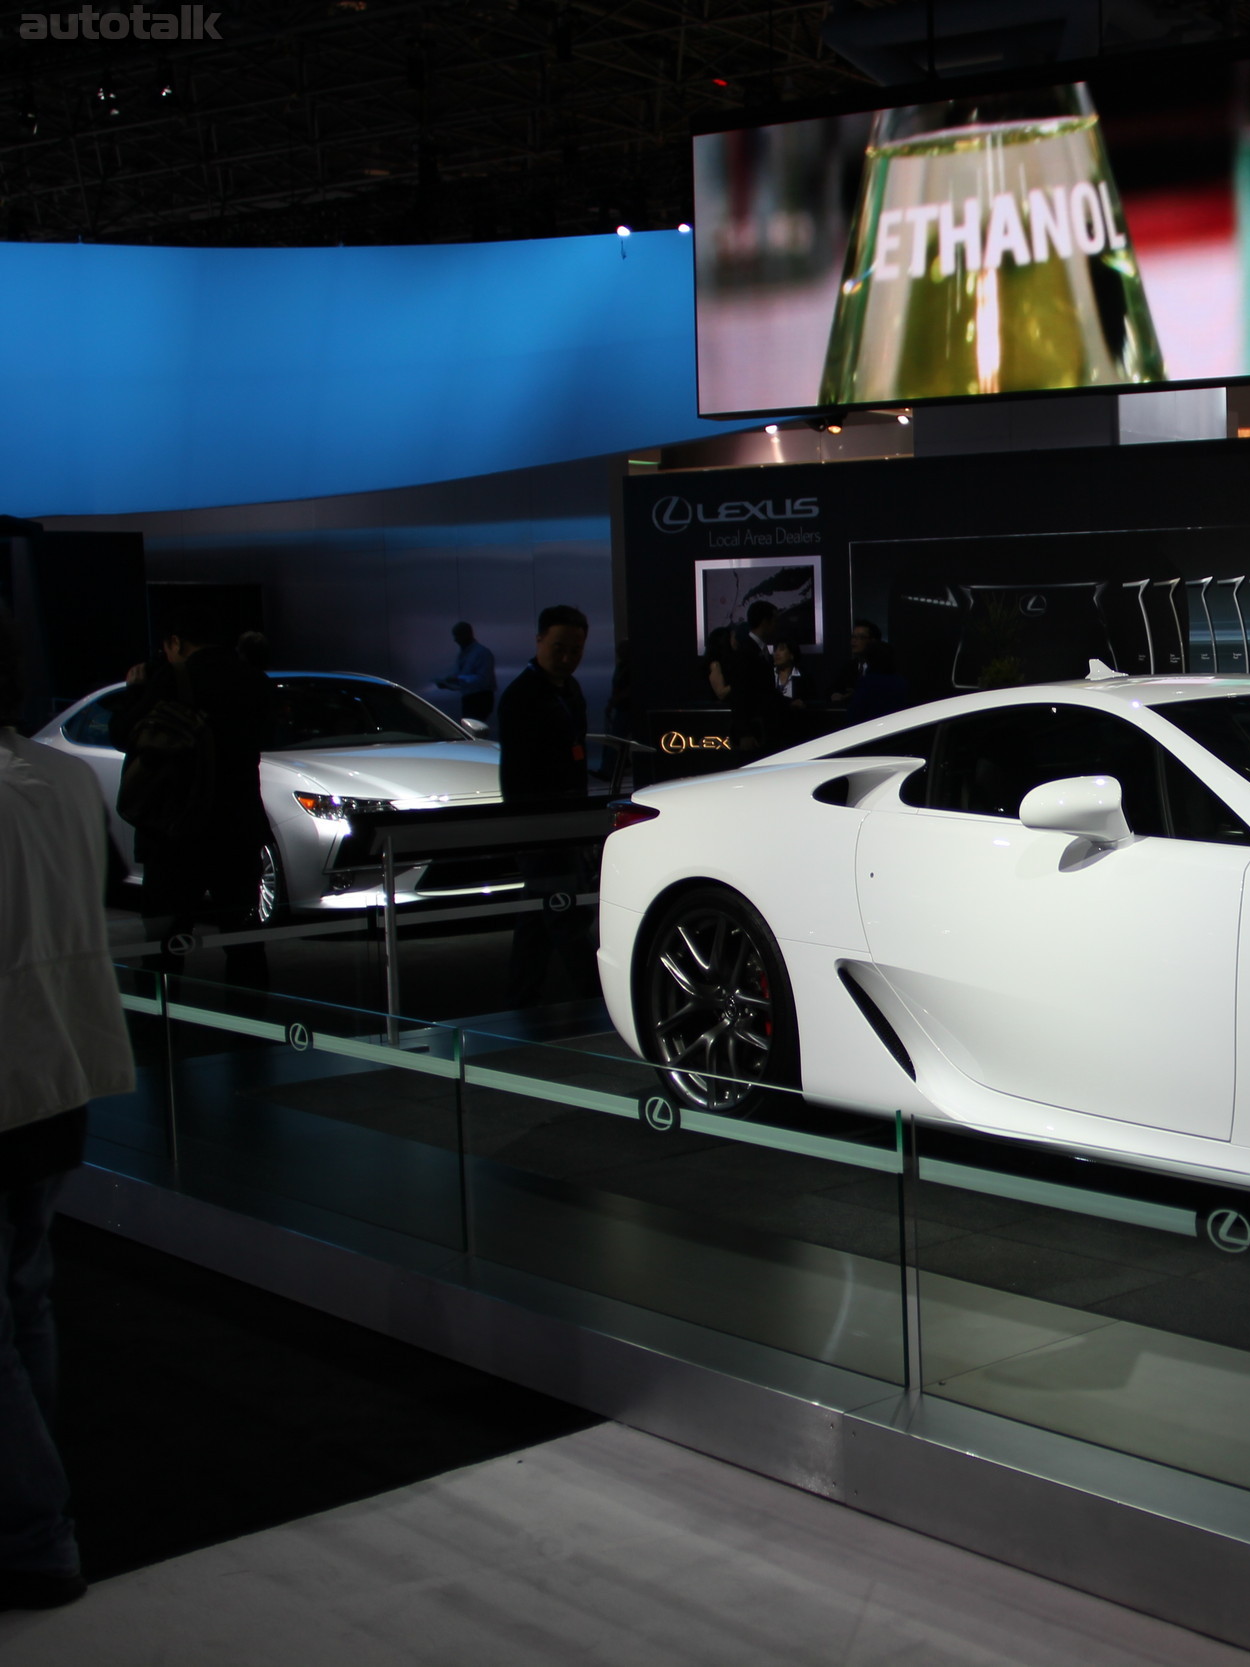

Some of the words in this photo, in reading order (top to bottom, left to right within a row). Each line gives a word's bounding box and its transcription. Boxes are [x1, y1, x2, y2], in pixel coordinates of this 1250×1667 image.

[873, 181, 1128, 281] ETHANOL
[697, 497, 820, 523] LEXUS
[708, 530, 740, 548] Local
[743, 529, 773, 546] Area
[775, 526, 822, 545] Dealers
